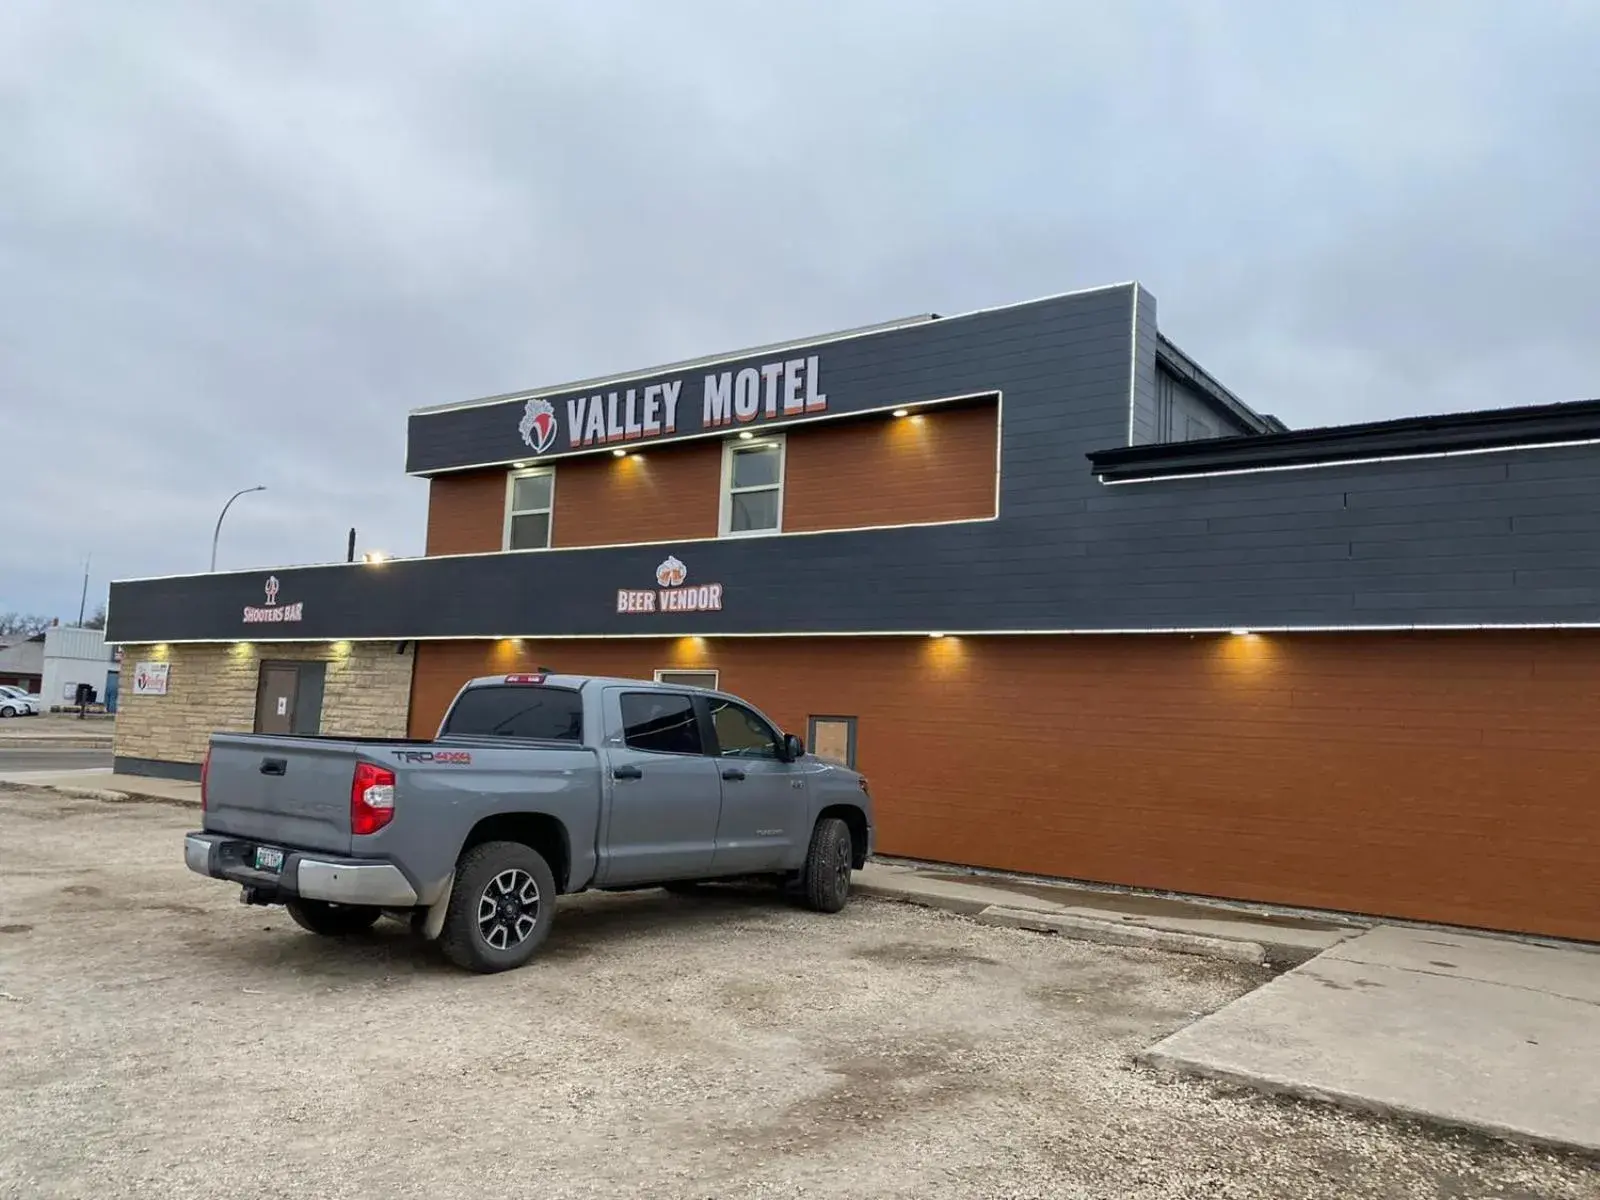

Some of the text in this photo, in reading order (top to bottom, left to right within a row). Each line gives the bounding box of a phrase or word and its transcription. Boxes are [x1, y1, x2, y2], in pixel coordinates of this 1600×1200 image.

[567, 355, 827, 447] VALLEY MOTEL
[243, 601, 303, 623] SHOOTERS BAR
[617, 583, 722, 613] BEER VENDOR
